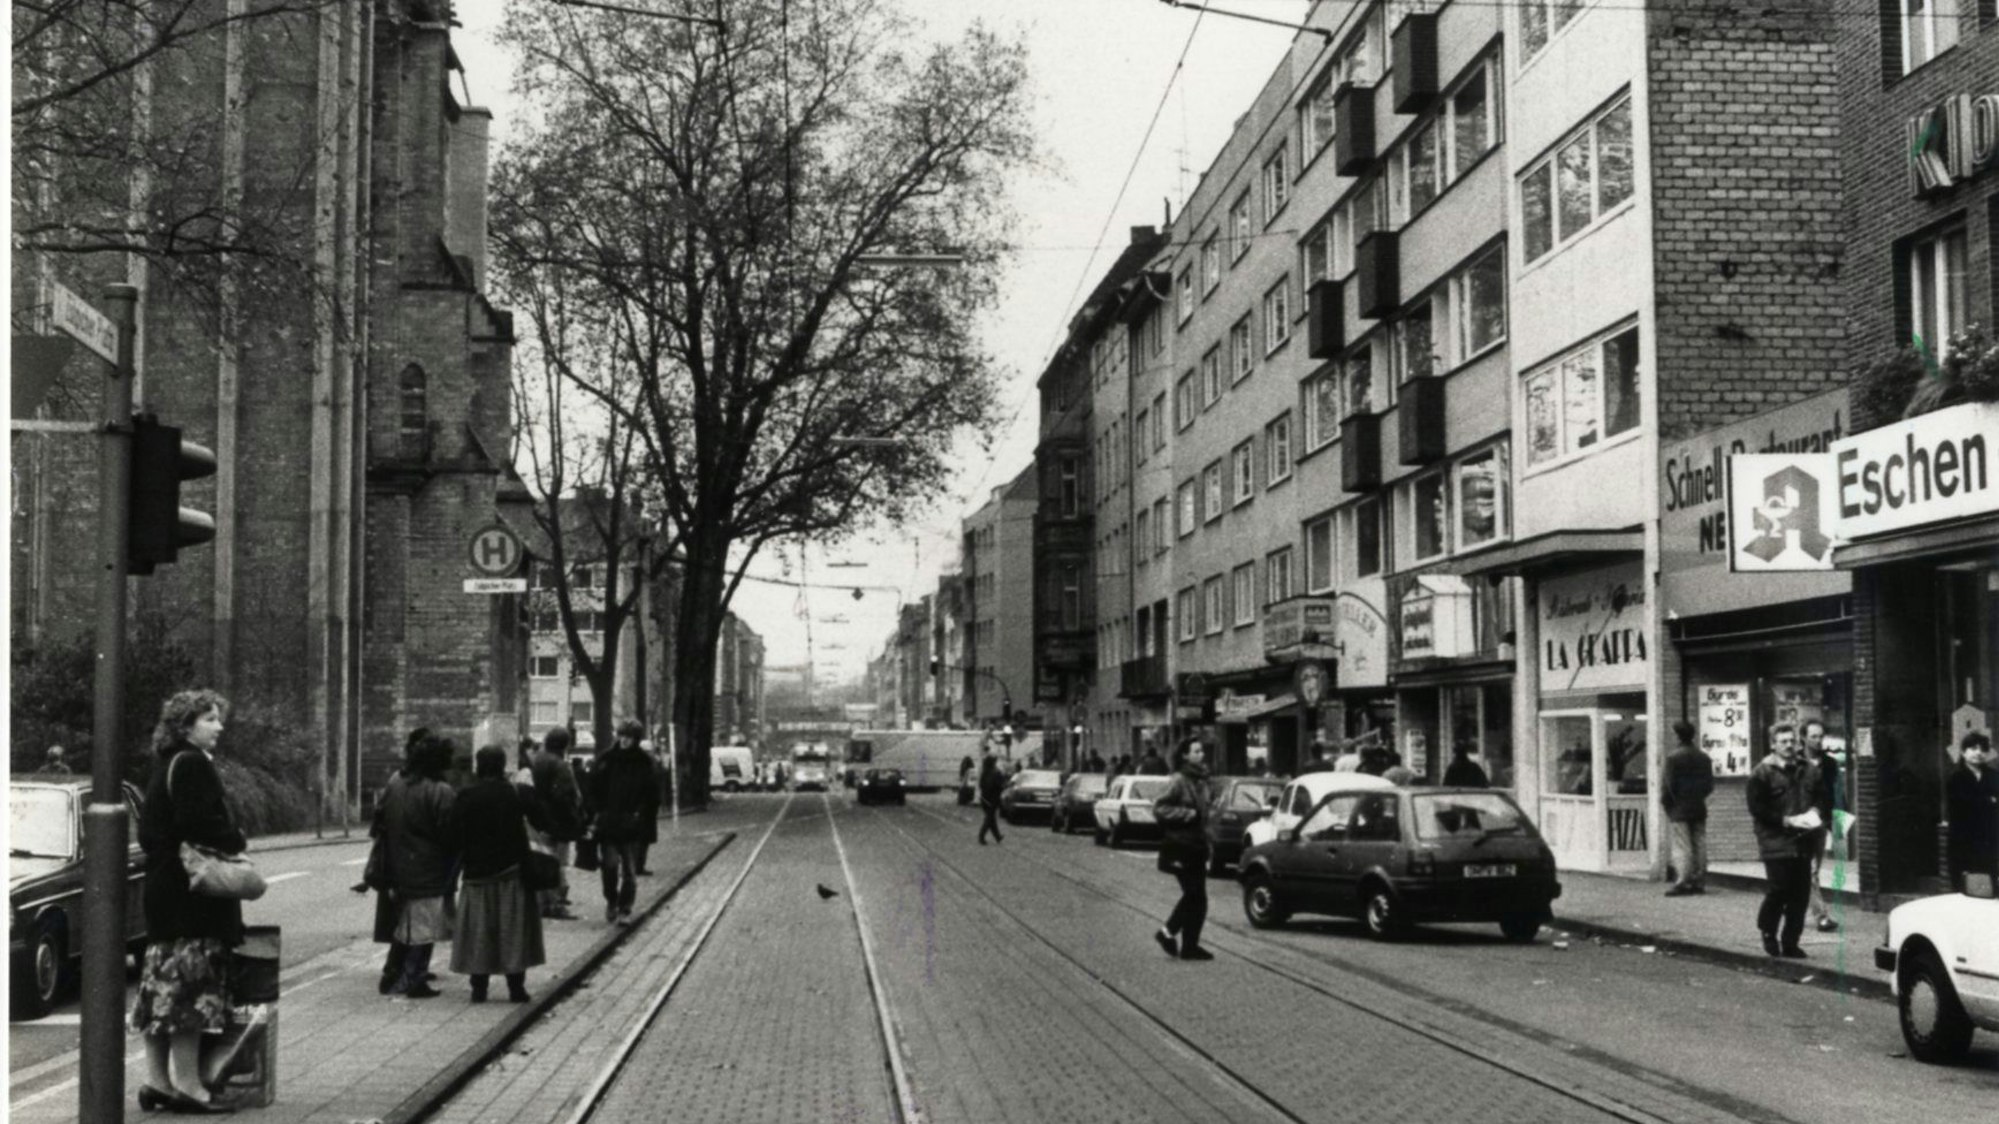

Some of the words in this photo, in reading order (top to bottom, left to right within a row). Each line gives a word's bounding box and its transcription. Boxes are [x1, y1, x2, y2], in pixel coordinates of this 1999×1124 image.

[1666, 446, 1723, 511] Schnell
[1838, 432, 1988, 519] Eschen
[482, 536, 507, 565] H
[1700, 511, 1726, 554] NE
[1547, 639, 1569, 671] LA
